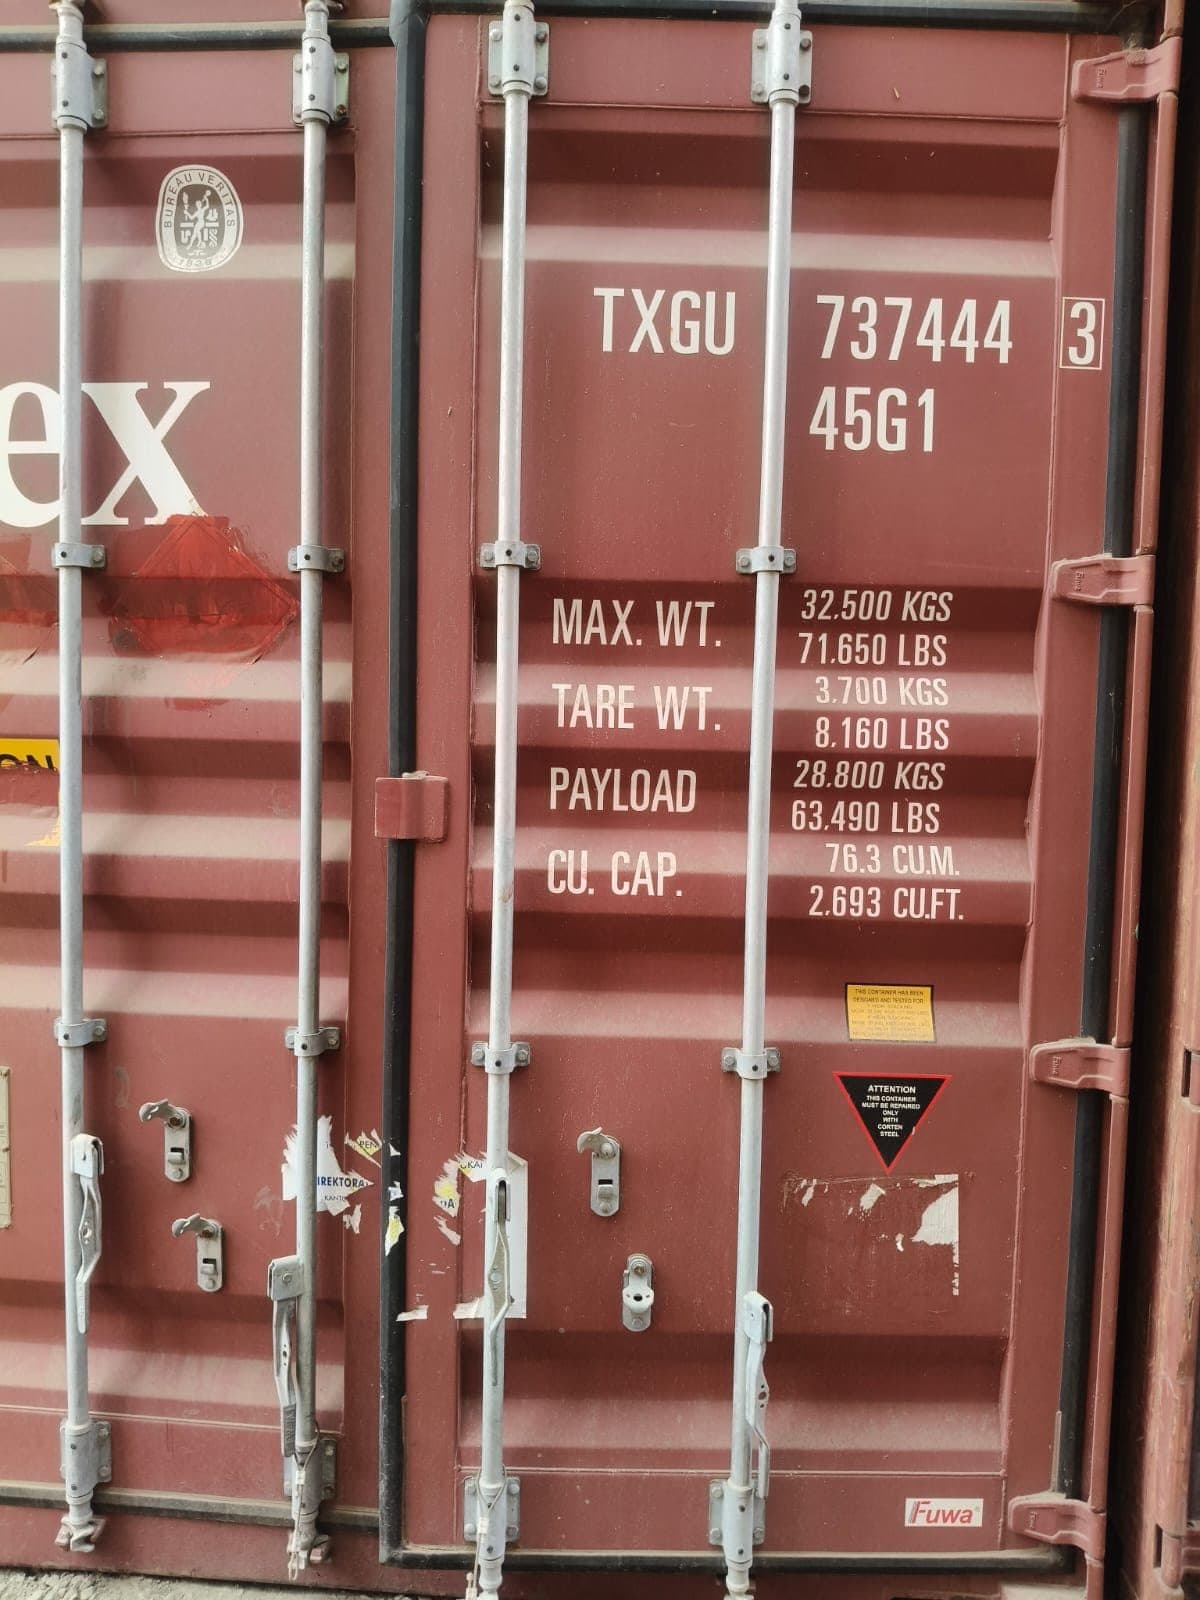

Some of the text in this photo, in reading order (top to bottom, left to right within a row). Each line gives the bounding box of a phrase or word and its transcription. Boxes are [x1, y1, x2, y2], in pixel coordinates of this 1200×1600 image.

[164, 172, 236, 228] BUREAU VERITAS
[593, 287, 1097, 366] TXGU 737444 3
[809, 386, 935, 453] 45G1
[552, 598, 721, 647] MAX. WT.
[801, 588, 953, 622] 32,500 KGS
[798, 632, 948, 667] 71,650 LBS
[551, 683, 721, 731] TARE WT.
[815, 675, 949, 706] 3,700 KGS
[815, 716, 950, 750] 8,160 LBS
[549, 766, 697, 813] PAYLOAD
[793, 759, 946, 791] 28,800 KGS
[791, 799, 940, 834] 63,490 LBS
[547, 849, 683, 897] CU. CAP.
[825, 842, 960, 876] 76.3 CU.M.
[808, 884, 964, 920] 2,693 CU.FT.
[868, 1084, 916, 1093] ATTENTION
[910, 1500, 973, 1524] Fuwa
